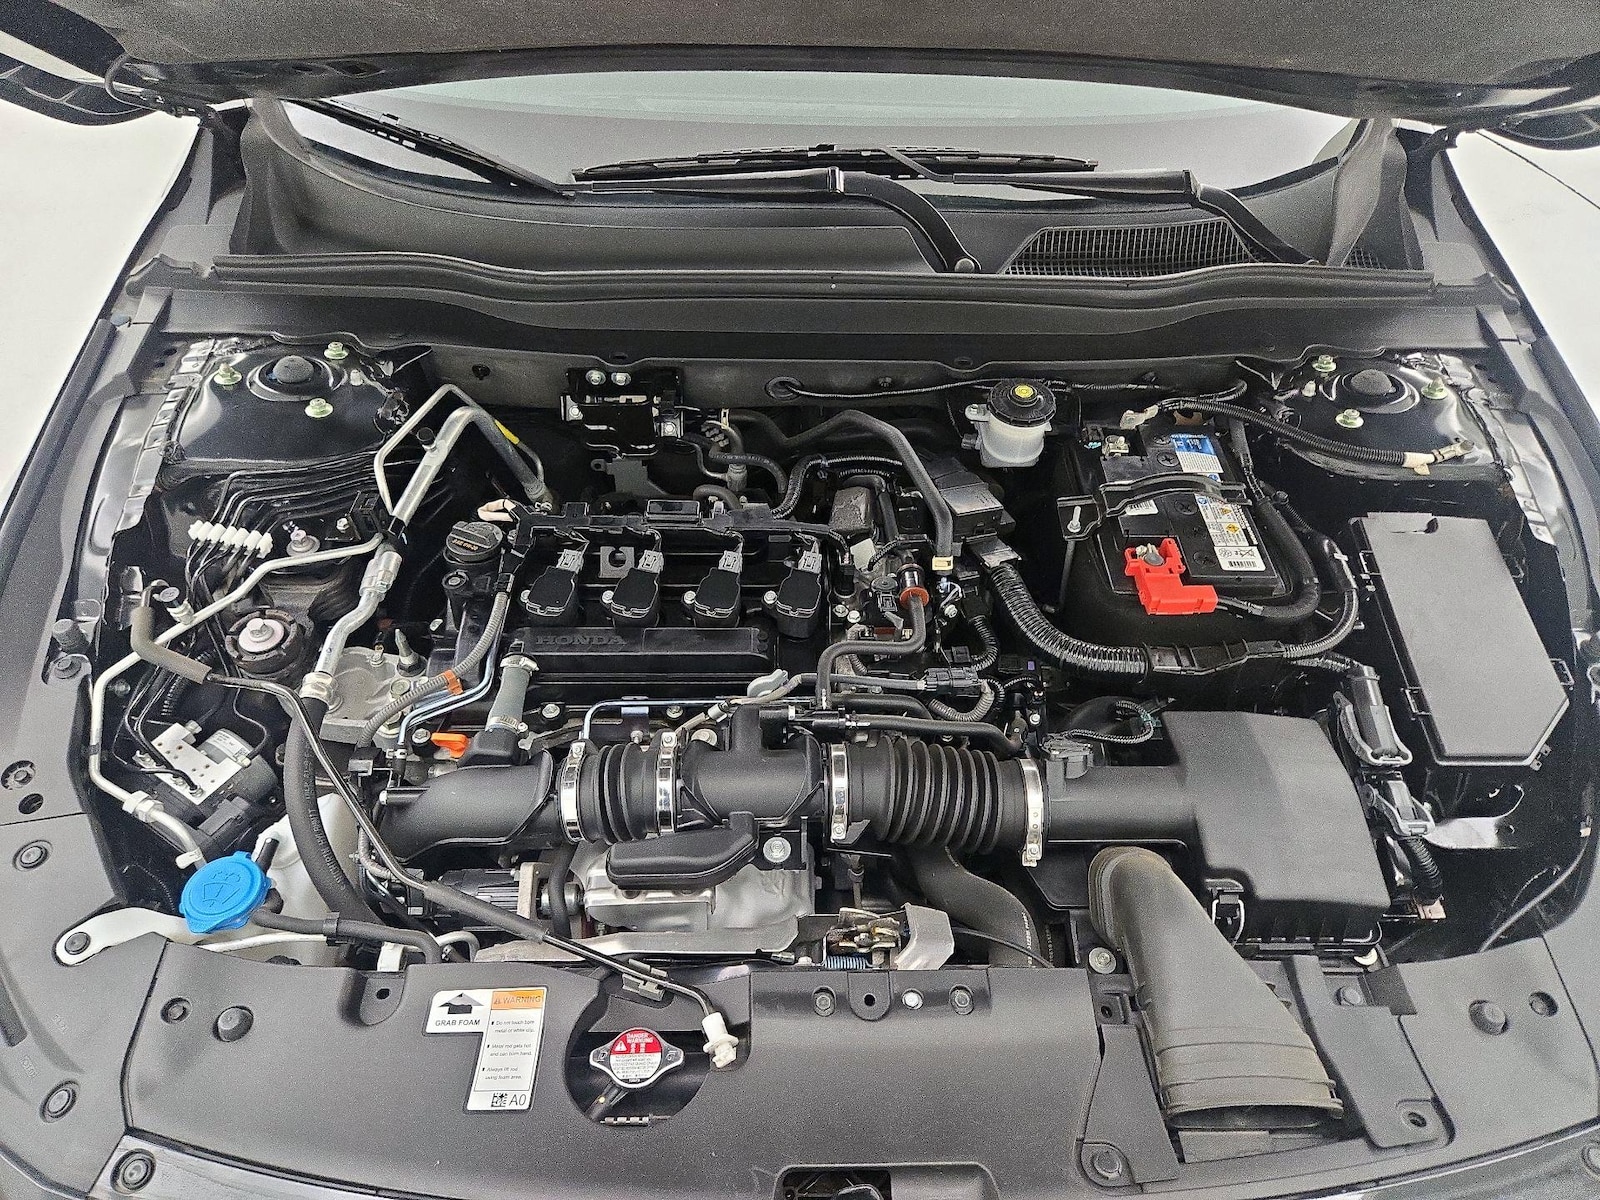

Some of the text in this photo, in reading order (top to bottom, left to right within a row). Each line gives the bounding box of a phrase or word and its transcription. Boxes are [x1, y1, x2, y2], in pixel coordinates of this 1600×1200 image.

[536, 634, 628, 646] HONDA
[503, 995, 542, 1005] WARNING
[435, 1019, 457, 1027] GRAB
[508, 1093, 527, 1106] A0
